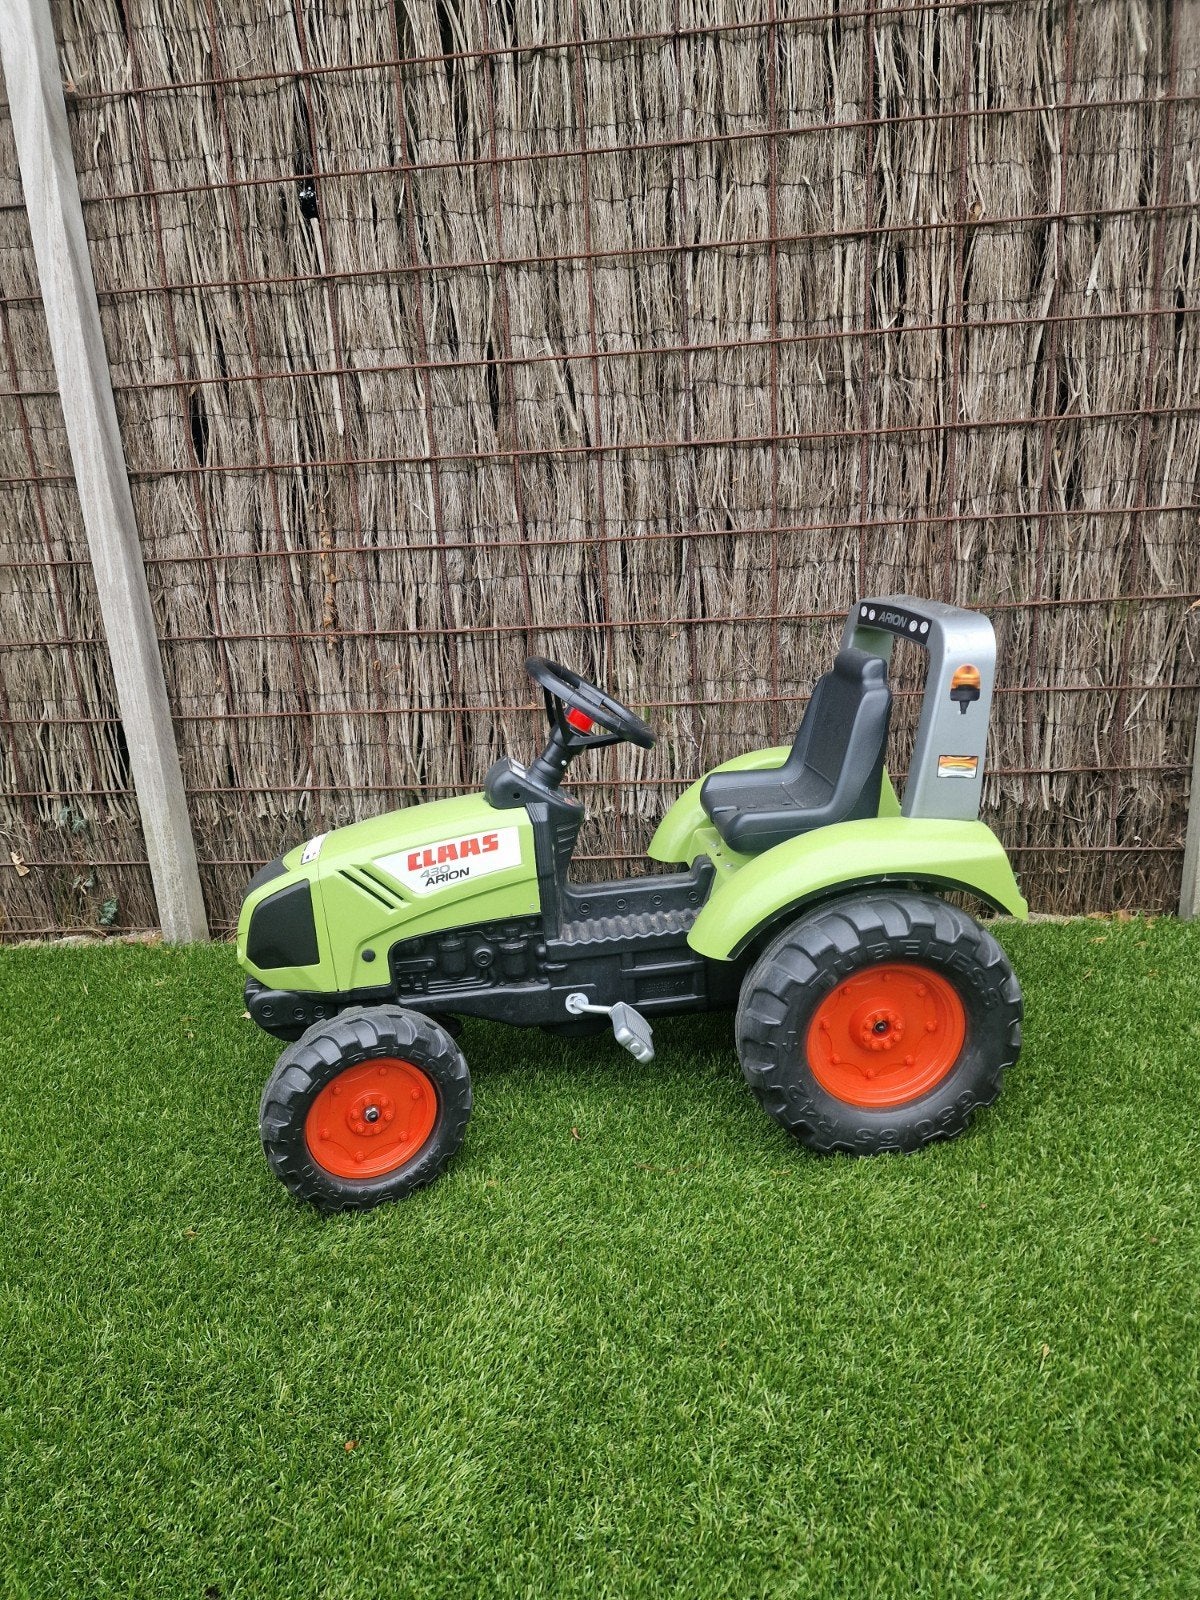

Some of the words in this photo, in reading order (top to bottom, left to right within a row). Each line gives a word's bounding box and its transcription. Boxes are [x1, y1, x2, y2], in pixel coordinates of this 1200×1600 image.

[878, 611, 908, 628] ARION
[407, 833, 499, 871] CLAAS
[420, 864, 450, 878] 430
[425, 867, 470, 887] ARION
